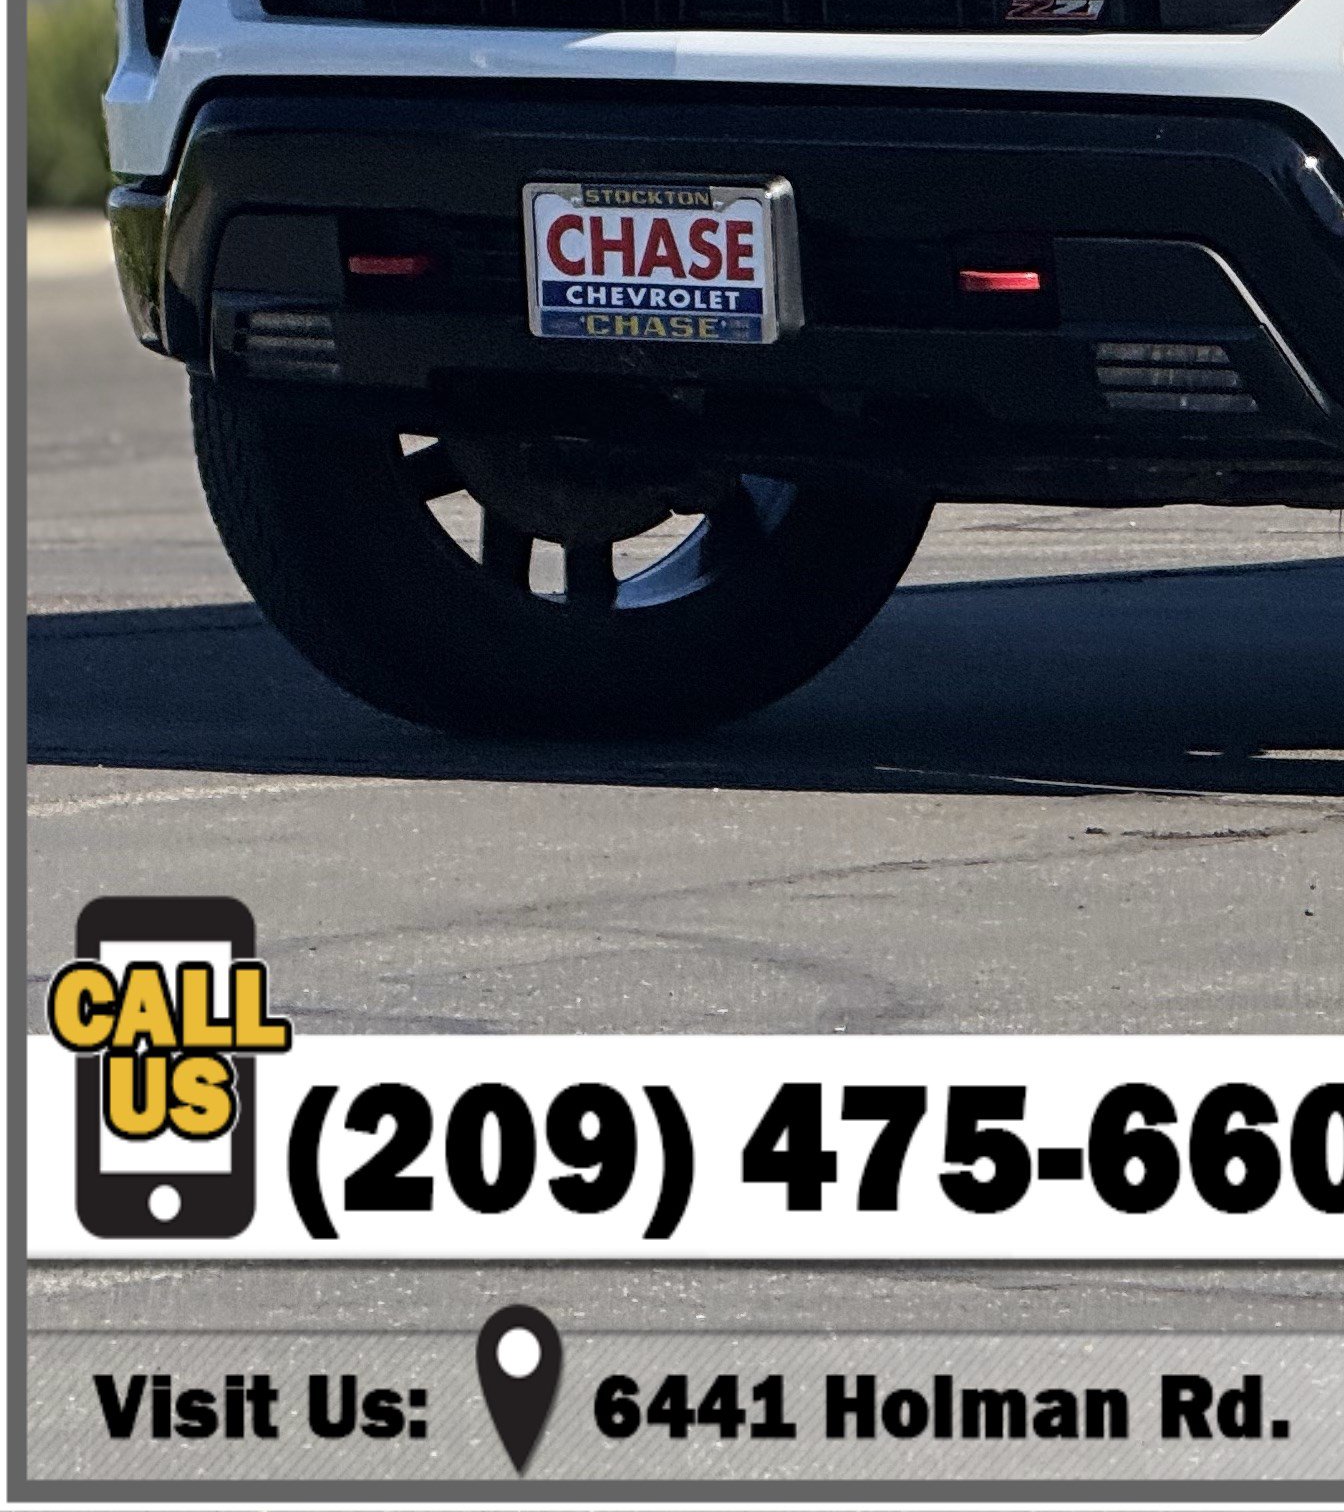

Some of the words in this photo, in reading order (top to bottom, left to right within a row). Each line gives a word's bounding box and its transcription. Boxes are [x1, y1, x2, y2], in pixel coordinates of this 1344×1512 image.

[584, 188, 710, 207] STOCKTON
[546, 213, 755, 281] CHASE
[565, 285, 740, 311] CHEVROLET
[585, 314, 721, 339] CHASE
